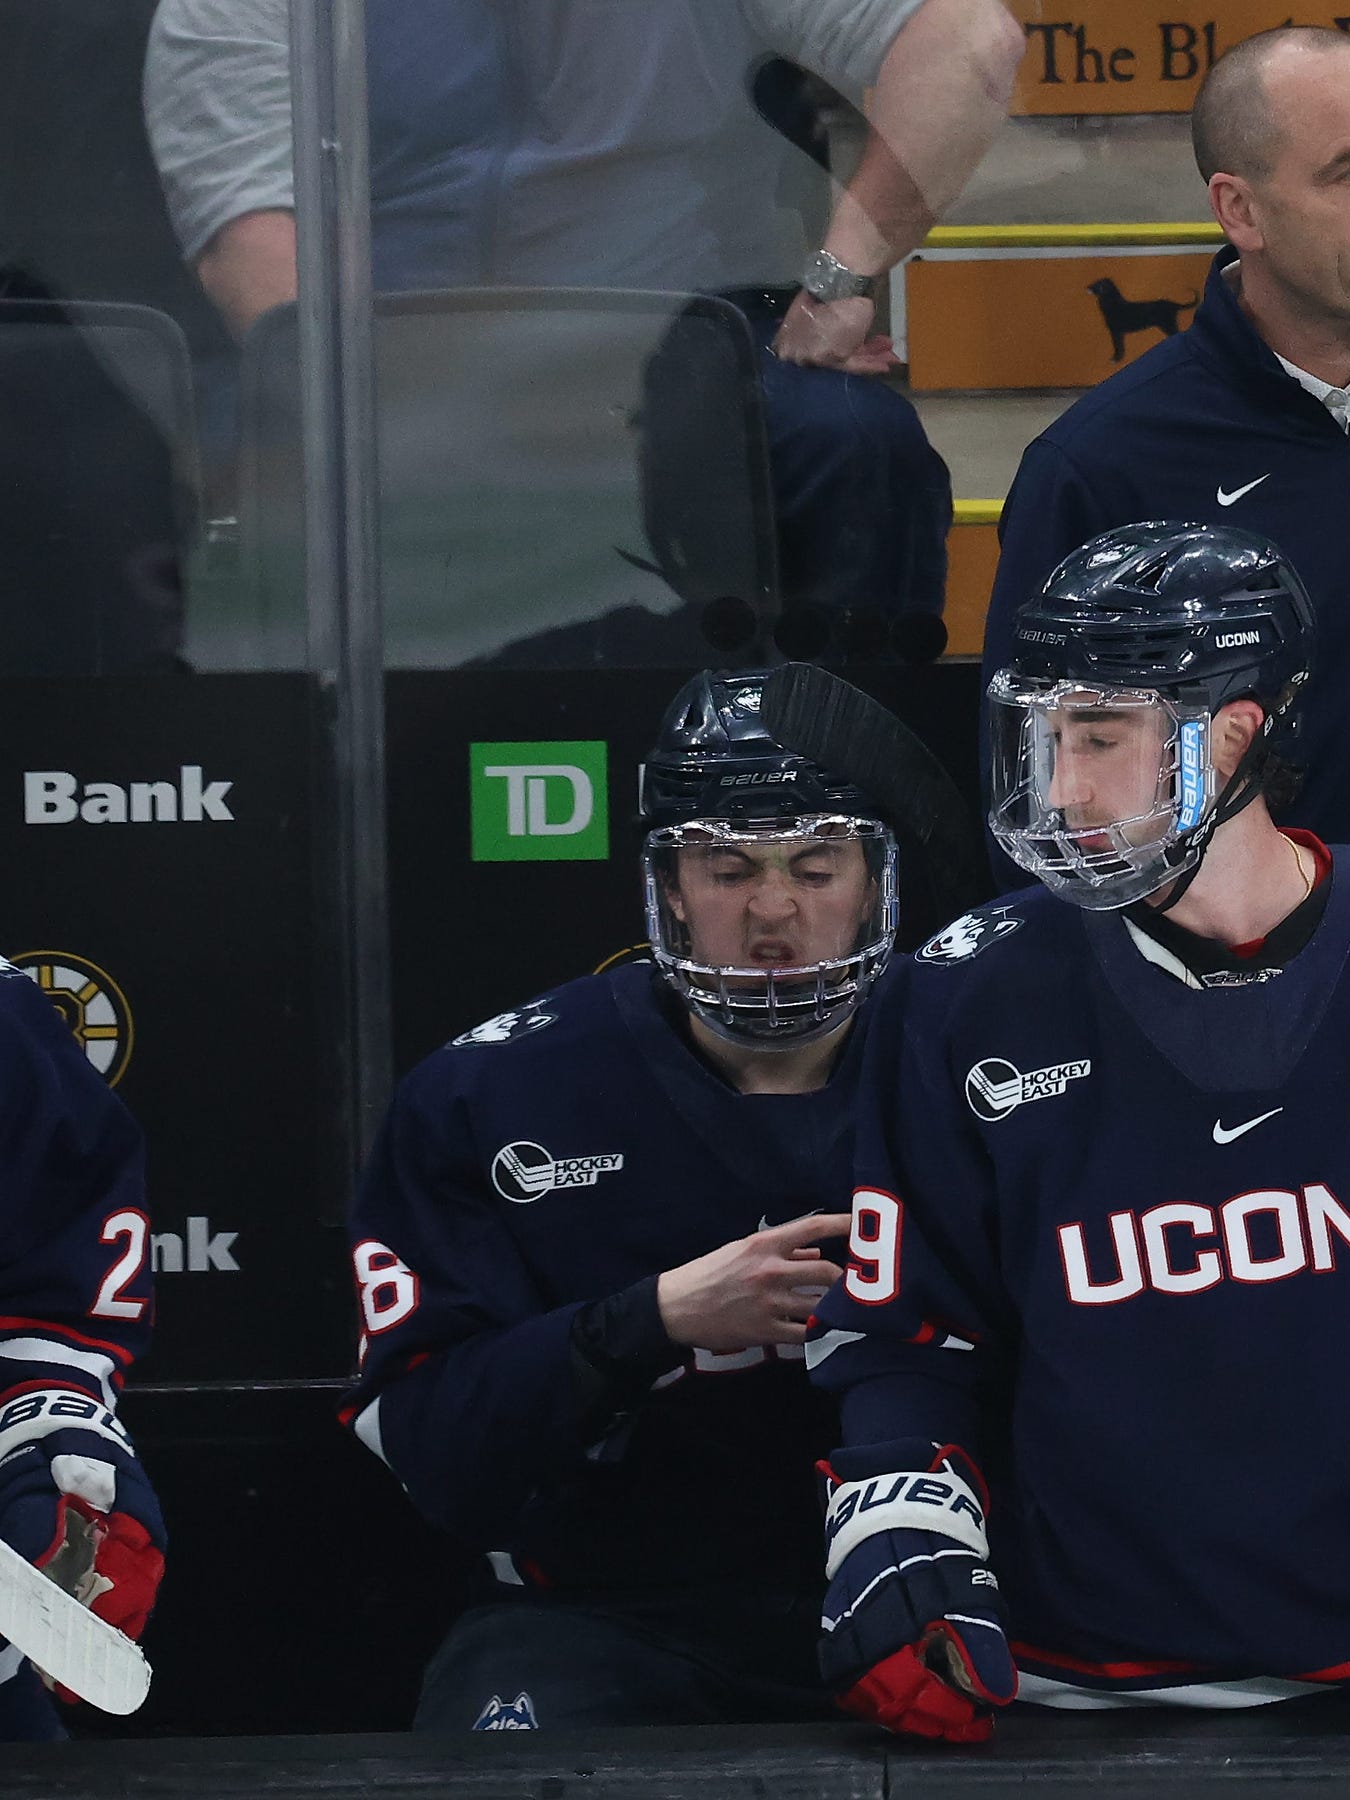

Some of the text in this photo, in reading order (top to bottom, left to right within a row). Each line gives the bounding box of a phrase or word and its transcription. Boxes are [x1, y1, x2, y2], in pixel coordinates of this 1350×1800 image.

[1024, 21, 1135, 84] The
[1215, 630, 1260, 648] UCONN
[24, 765, 235, 825] Bank
[485, 765, 594, 837] TD
[1022, 1062, 1087, 1088] HOCKEY
[1022, 1080, 1062, 1101] EAST
[555, 1155, 619, 1173] HOCKEY
[554, 1171, 593, 1186] EAST
